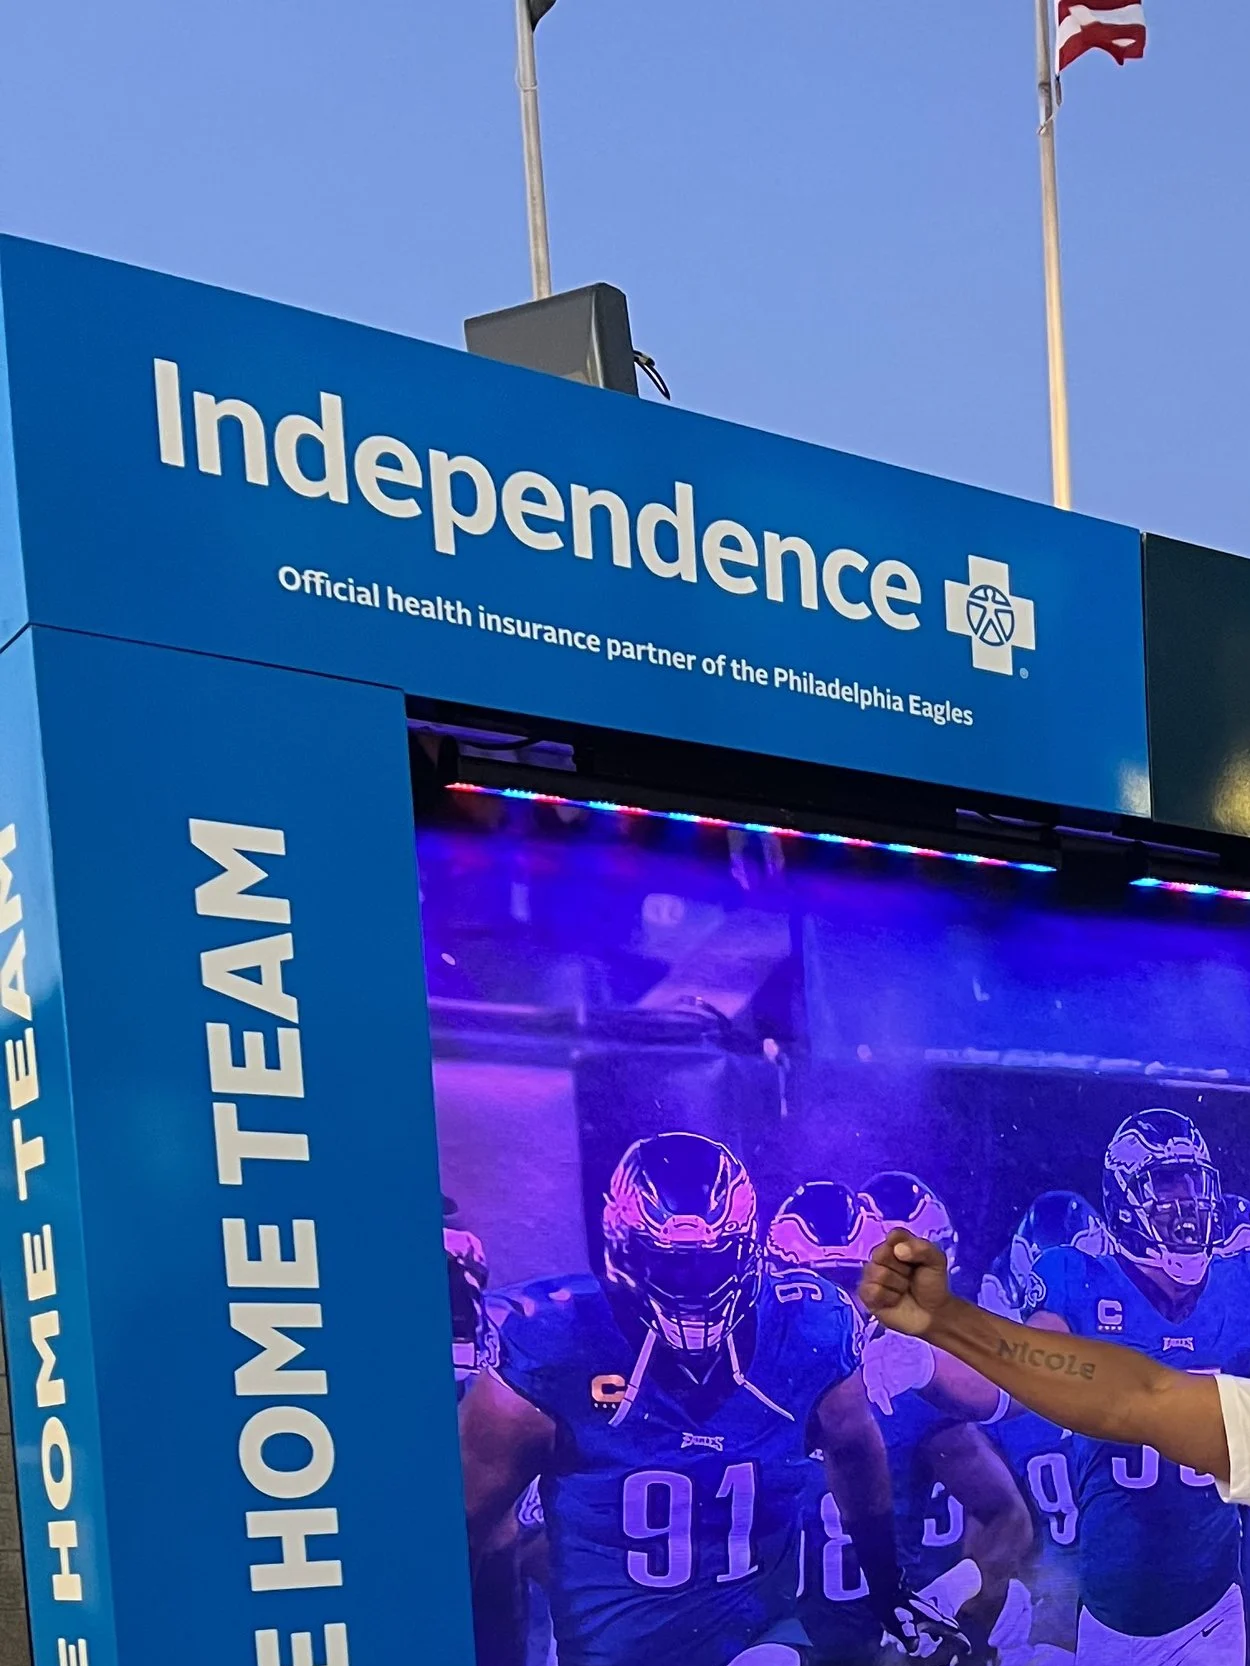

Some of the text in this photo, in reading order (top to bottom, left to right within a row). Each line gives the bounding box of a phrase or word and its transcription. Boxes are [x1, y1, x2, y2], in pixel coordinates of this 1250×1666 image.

[153, 358, 922, 631] Independence
[277, 565, 975, 727] Official health insurance partner of the Philadelphia Eagles
[0, 822, 47, 1201] TEAM
[188, 818, 310, 1186] TEAM
[22, 1223, 84, 1603] HOME
[222, 1217, 343, 1592] HOME
[622, 1461, 759, 1588] 91
